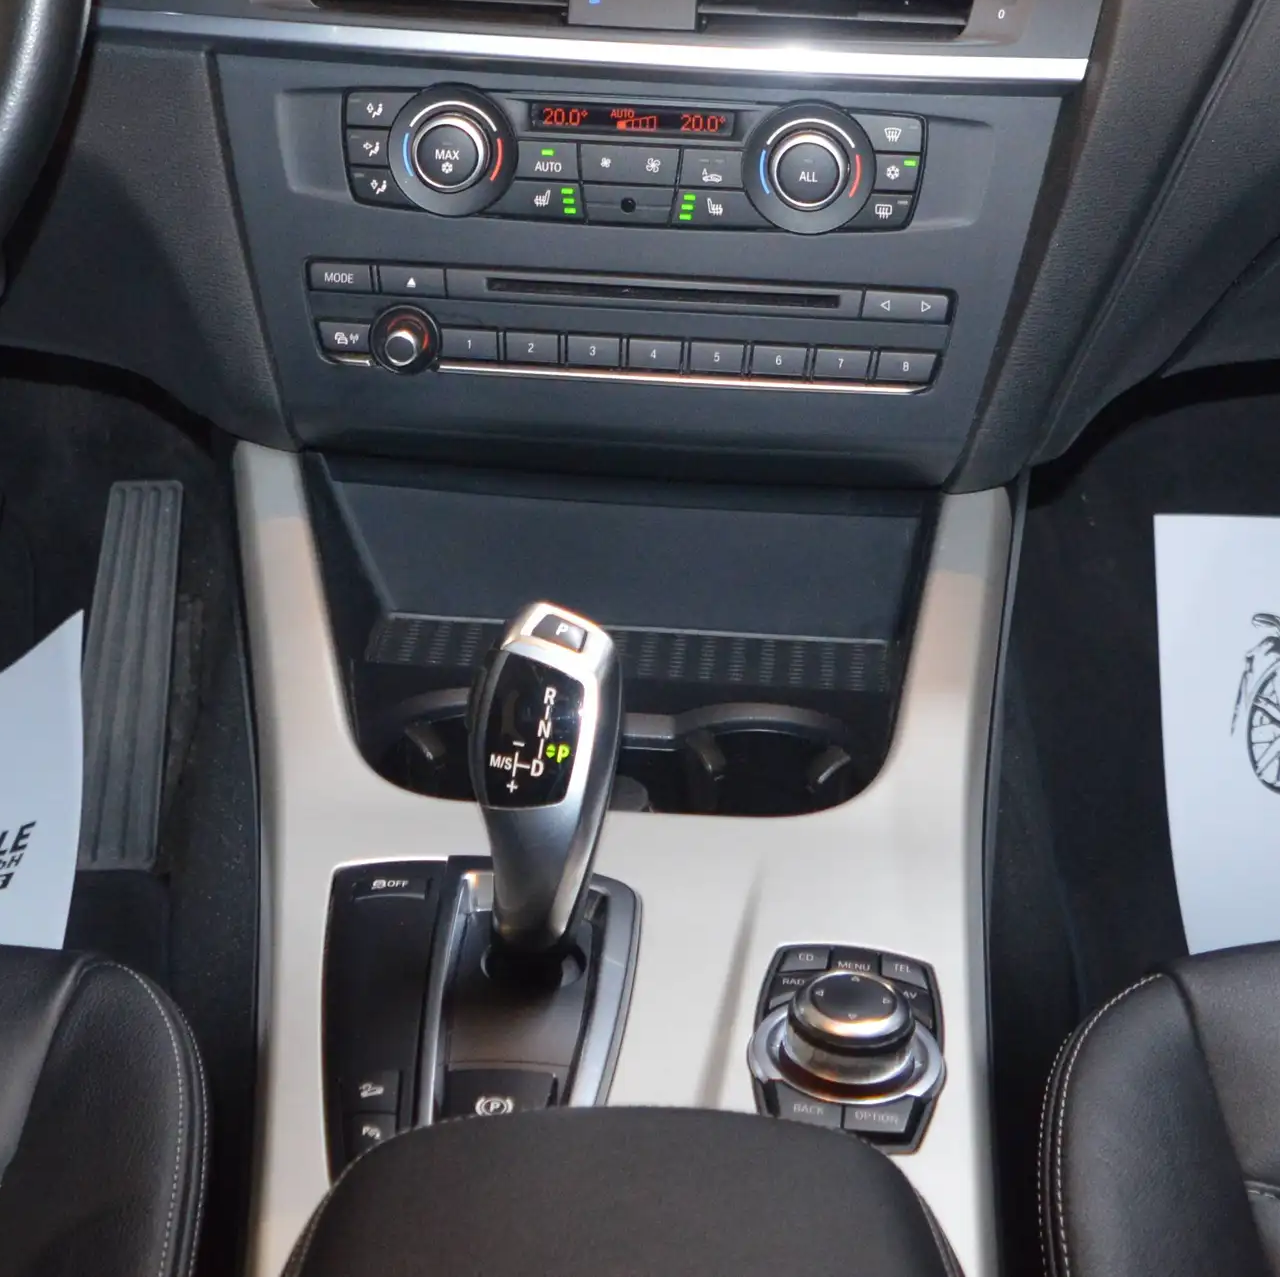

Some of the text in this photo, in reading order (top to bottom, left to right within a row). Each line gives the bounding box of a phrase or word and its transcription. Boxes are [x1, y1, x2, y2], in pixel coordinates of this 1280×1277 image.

[610, 109, 635, 119] AUTO
[435, 149, 460, 161] MAX
[535, 161, 562, 173] AUTO
[799, 171, 818, 183] ALL
[324, 272, 354, 284] MODE
[527, 342, 534, 353] 2
[589, 346, 596, 356] 3
[650, 349, 657, 359] 4
[713, 352, 720, 362] 5
[775, 355, 782, 365] 6
[838, 358, 844, 369] 7
[903, 361, 909, 372] 8
[556, 623, 569, 635] P
[544, 687, 557, 705] R
[538, 720, 551, 738] N
[557, 743, 570, 763] P
[489, 754, 544, 777] M/S D
[387, 879, 409, 888] OFF
[798, 953, 814, 962] CD
[837, 960, 871, 972] MENU
[893, 963, 911, 973] TEL
[793, 1103, 824, 1116] BACK
[854, 1110, 899, 1124] OPTION
